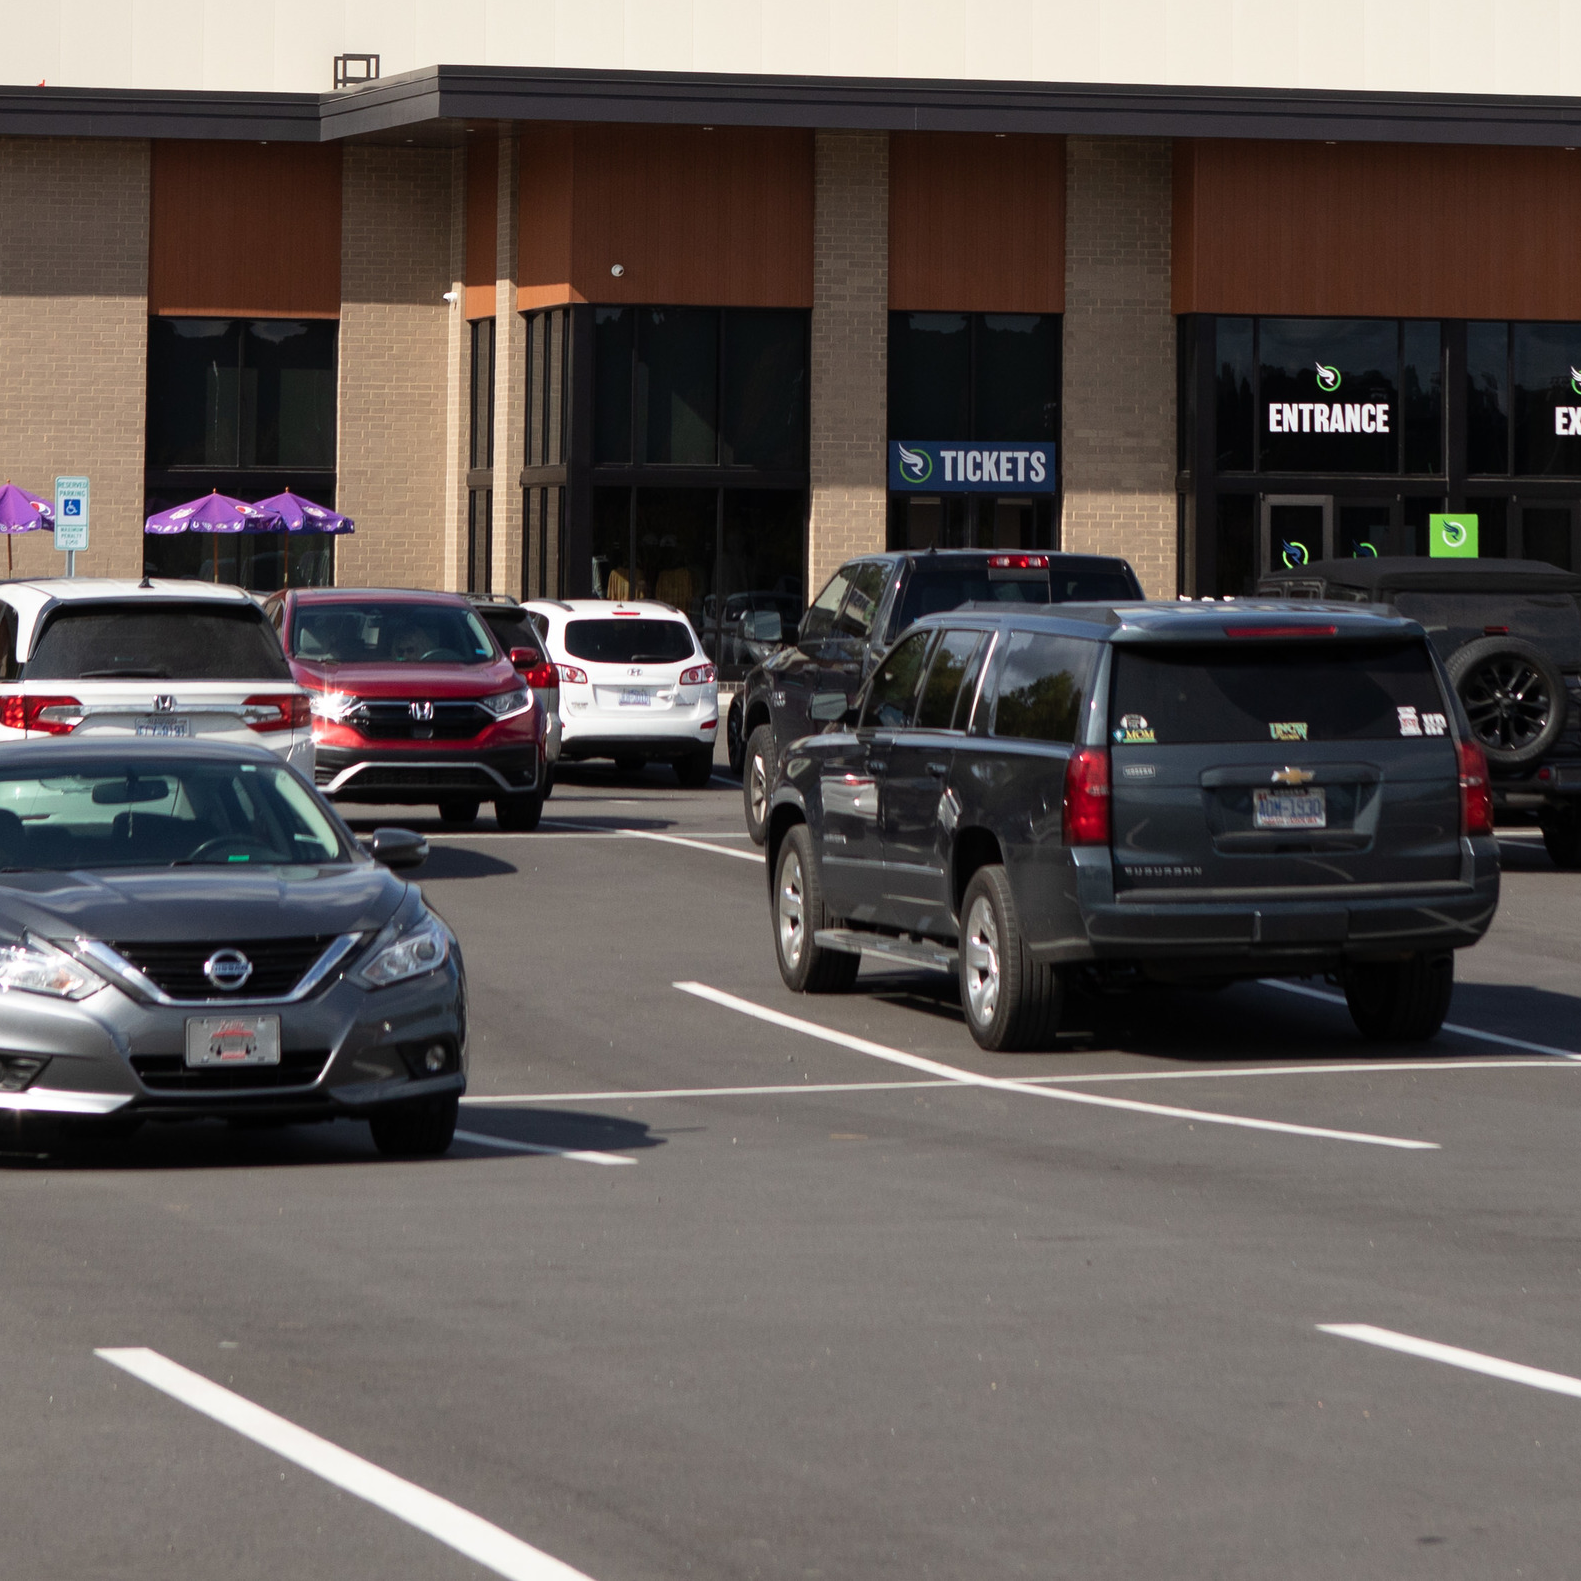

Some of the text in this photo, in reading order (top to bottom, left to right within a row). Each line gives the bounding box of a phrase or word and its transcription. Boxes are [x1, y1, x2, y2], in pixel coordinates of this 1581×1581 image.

[1268, 403, 1390, 433] ENTRANCE
[939, 450, 1047, 483] TICKETS
[57, 481, 88, 489] RESERVED
[59, 489, 86, 497] PARKING
[1125, 728, 1155, 740] MOM
[1124, 866, 1203, 876] SUBURBAN
